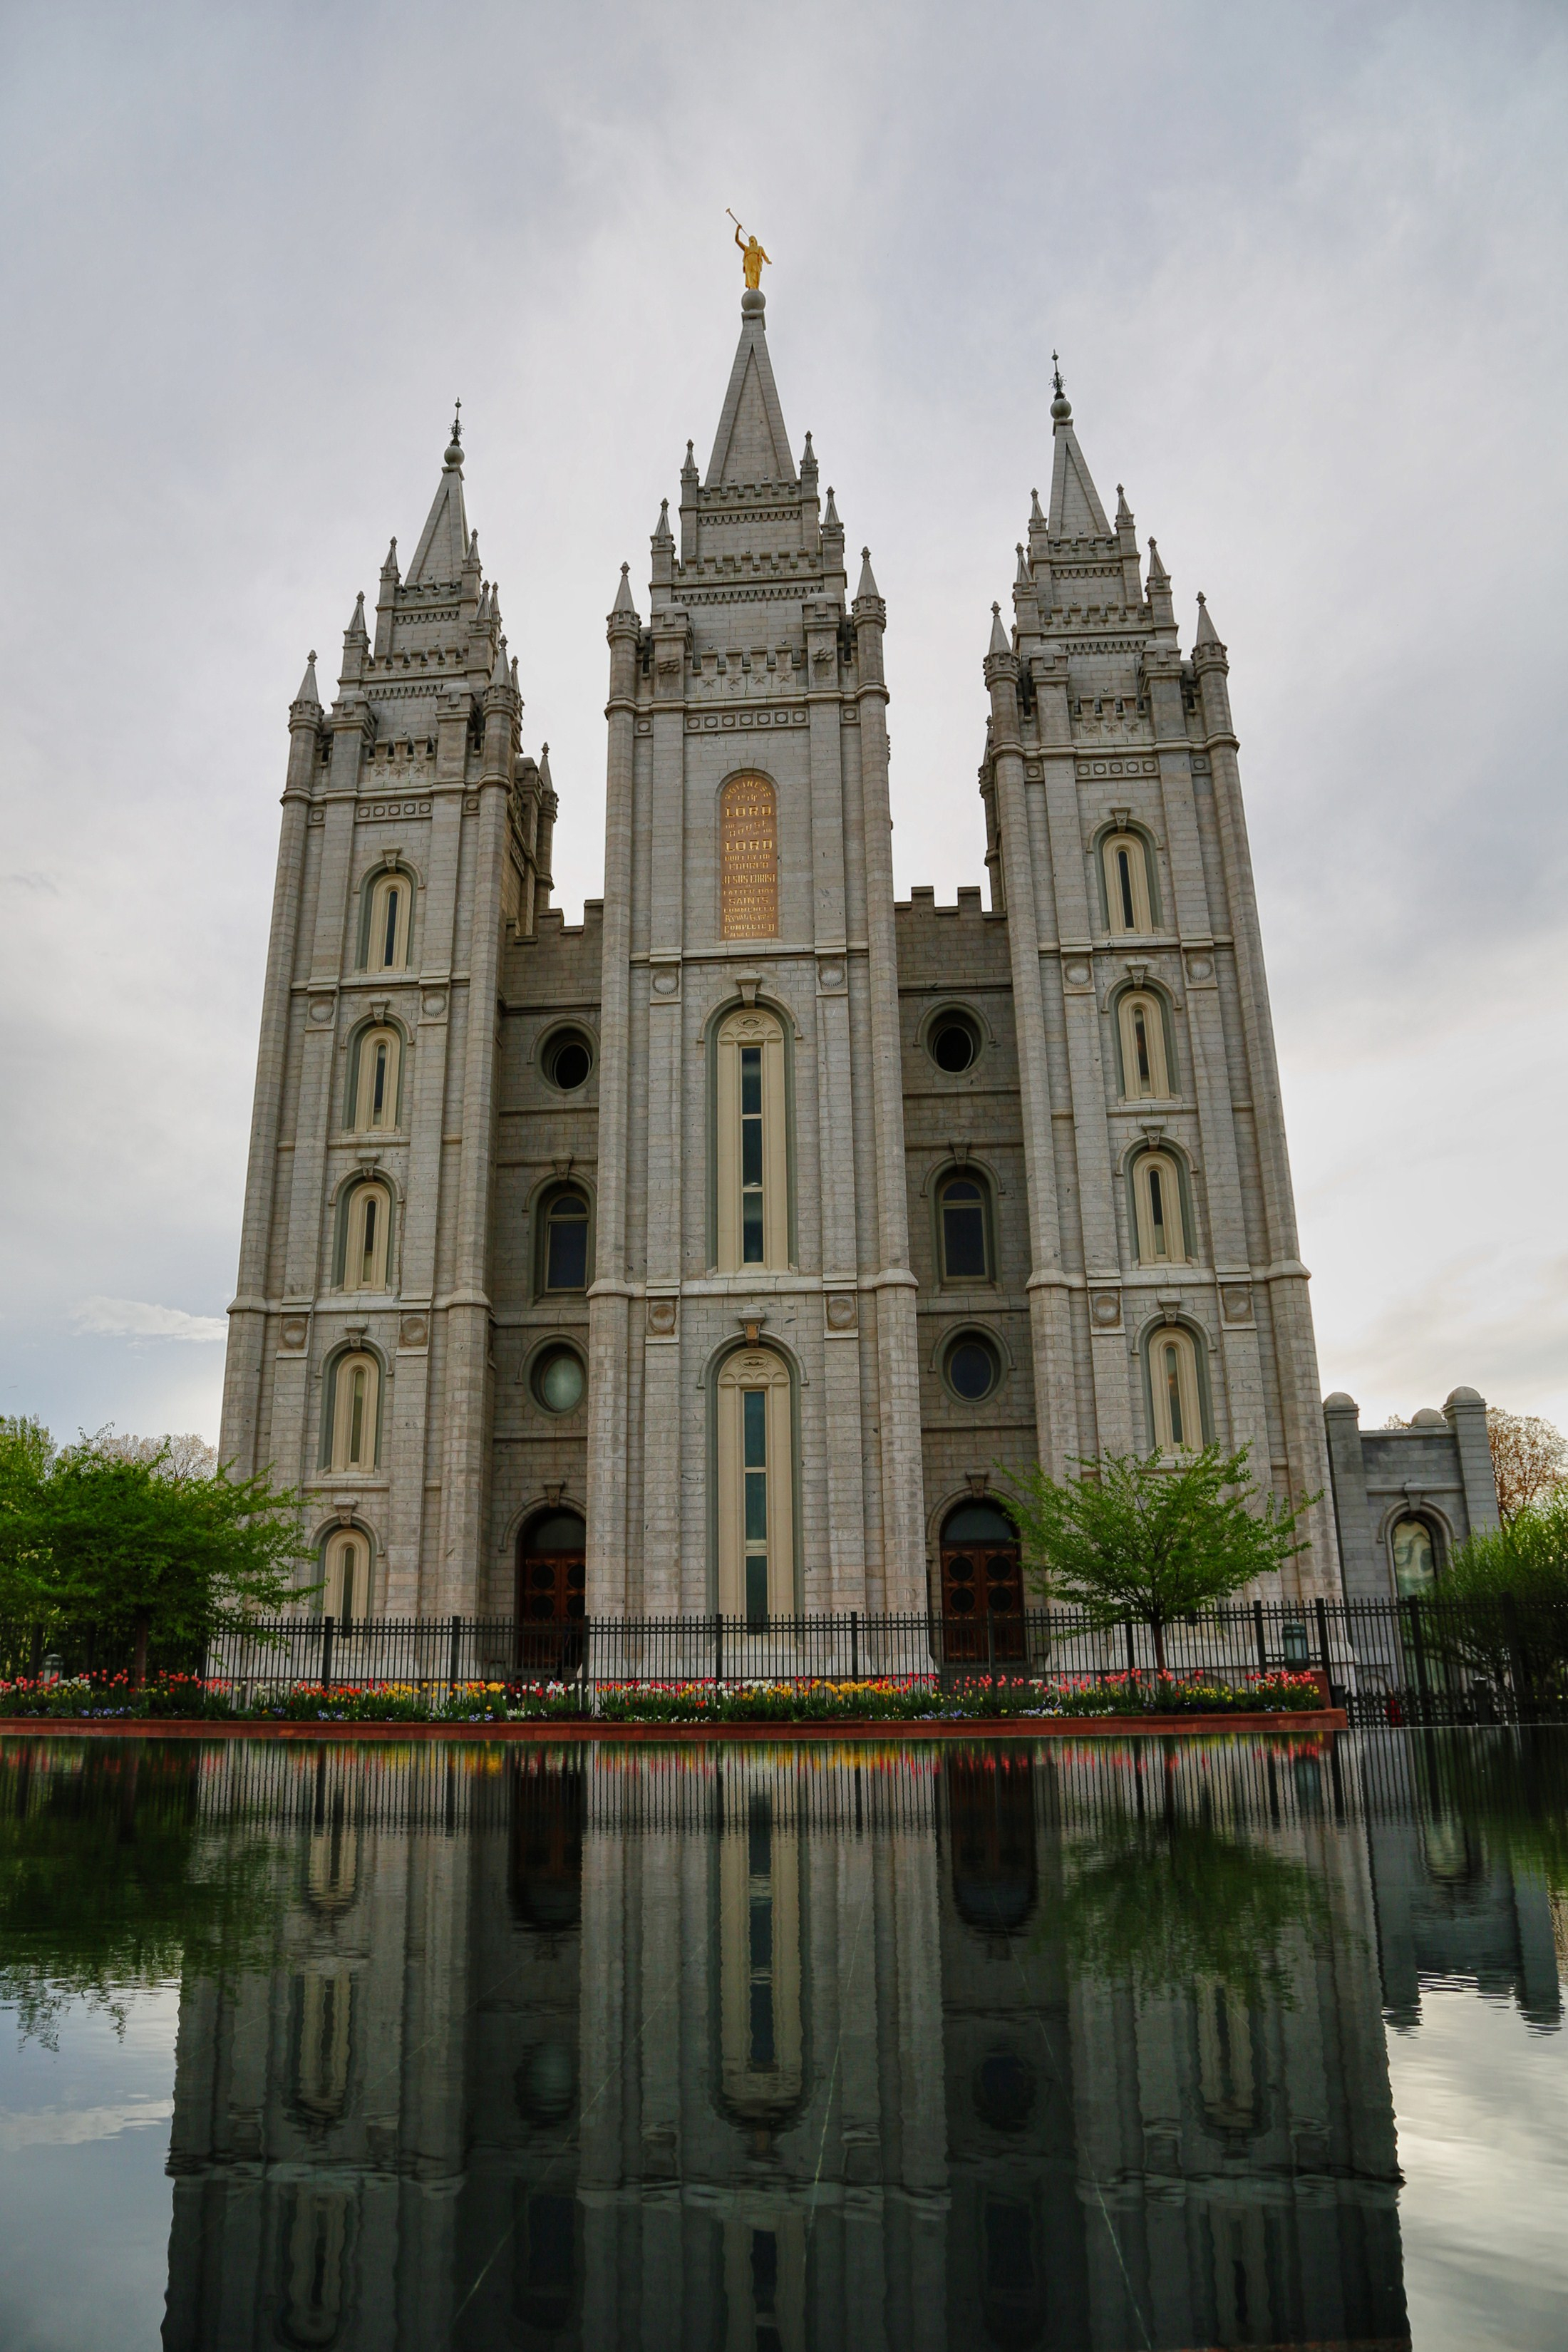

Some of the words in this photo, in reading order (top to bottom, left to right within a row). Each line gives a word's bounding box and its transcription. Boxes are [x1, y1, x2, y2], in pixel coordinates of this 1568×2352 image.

[729, 820, 768, 837] HOUSE
[725, 839, 773, 852] LORD
[729, 861, 768, 870] CHURCH
[722, 875, 748, 884] JESUS
[750, 872, 775, 883] CHRIST
[725, 913, 748, 922] APRIL
[724, 923, 775, 934] COMPLETED
